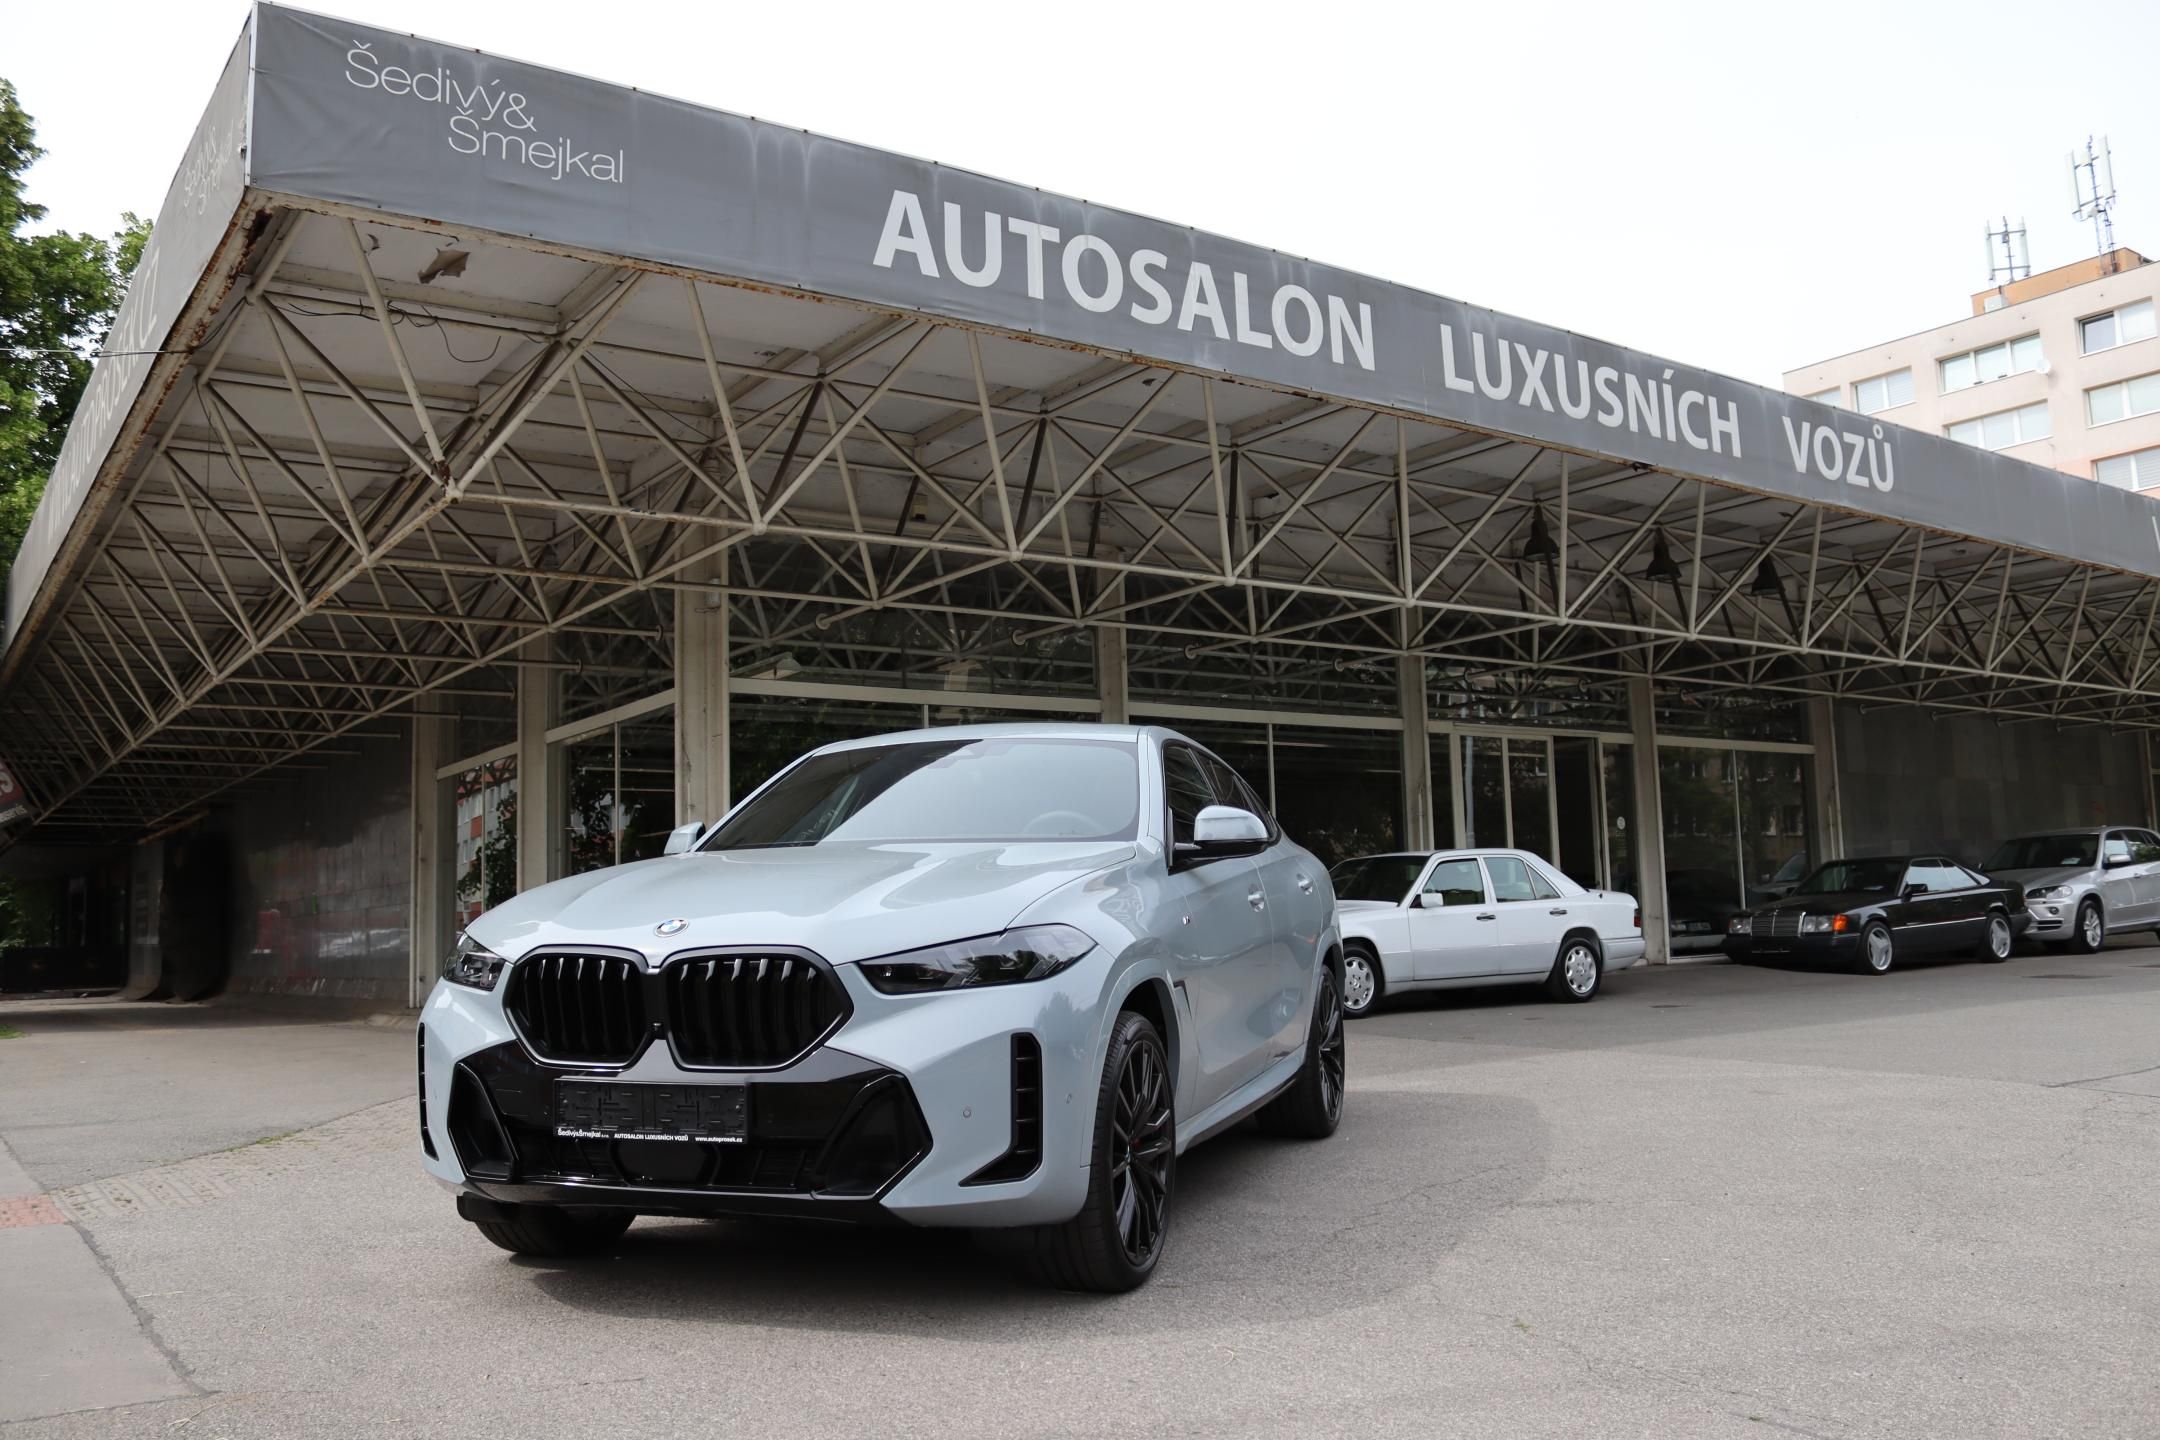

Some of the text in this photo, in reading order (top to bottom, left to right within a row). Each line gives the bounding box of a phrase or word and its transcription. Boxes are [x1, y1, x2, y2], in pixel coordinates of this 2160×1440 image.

[345, 39, 537, 132] Šedivý&
[448, 105, 624, 183] Šmejkal
[872, 189, 1895, 493] AUTOSALON LUXUSNÍCH VOZŮ
